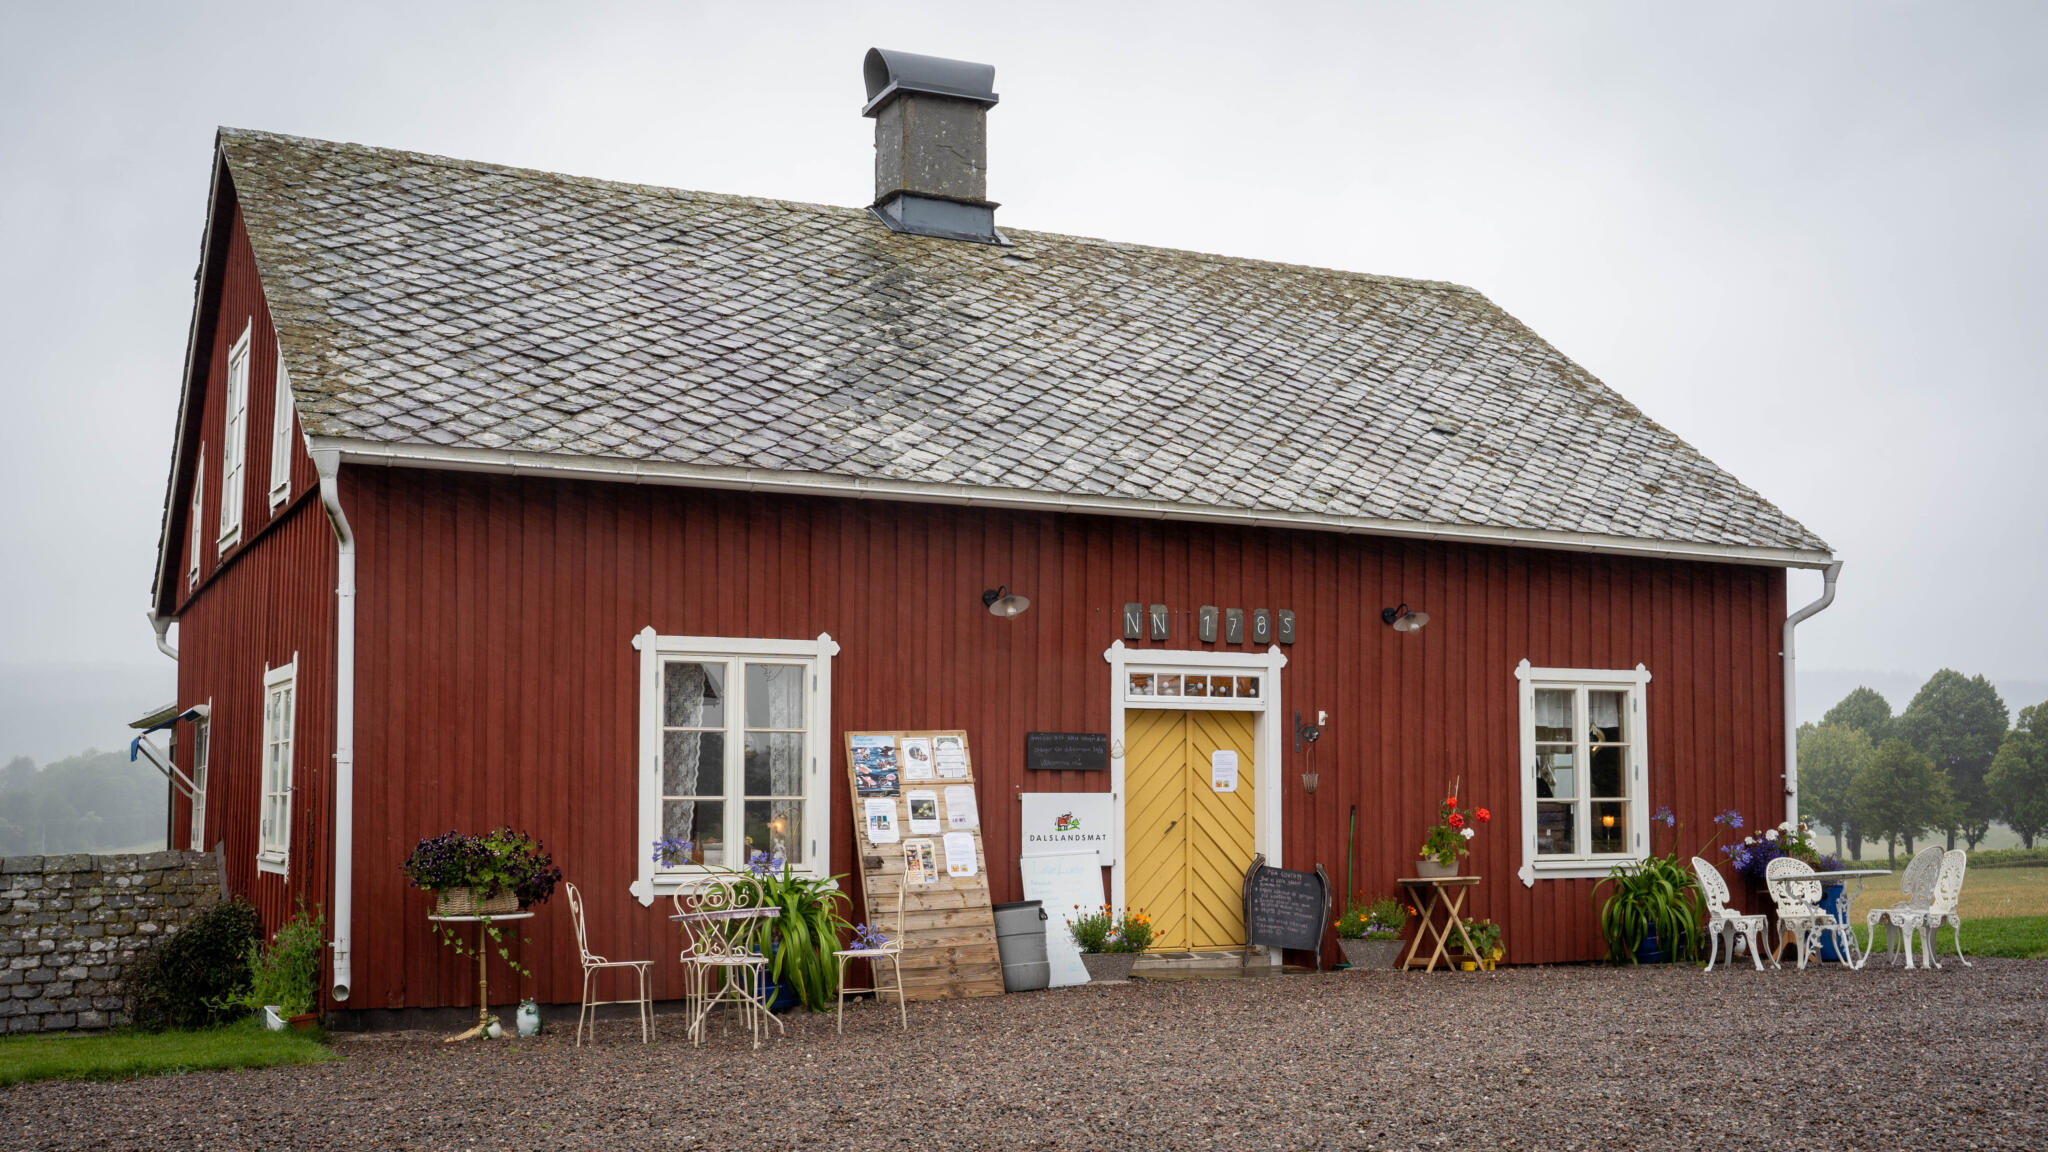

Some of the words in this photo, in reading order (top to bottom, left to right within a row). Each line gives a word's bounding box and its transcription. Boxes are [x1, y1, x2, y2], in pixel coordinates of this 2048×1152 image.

[1127, 612, 1166, 635] NN
[1203, 615, 1292, 636] 1785
[1029, 834, 1107, 842] DALSLANDSMAT
